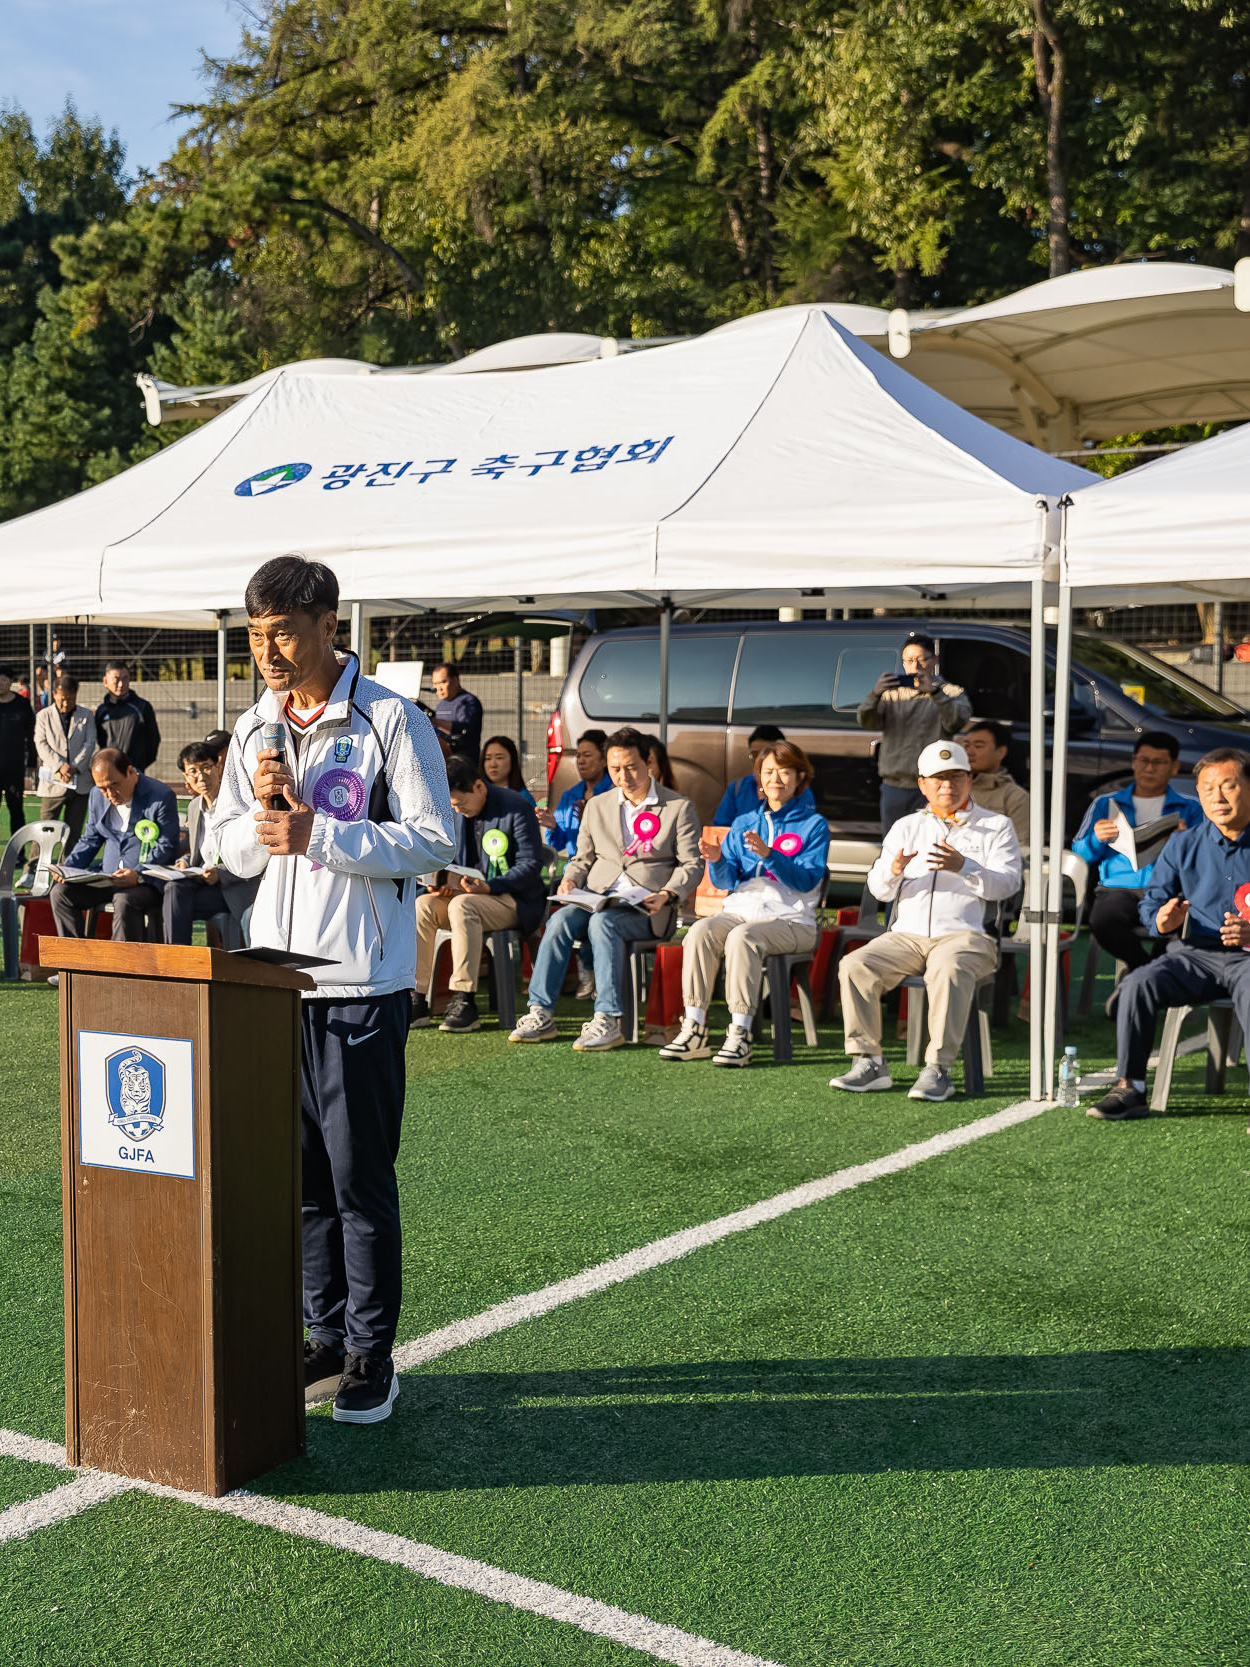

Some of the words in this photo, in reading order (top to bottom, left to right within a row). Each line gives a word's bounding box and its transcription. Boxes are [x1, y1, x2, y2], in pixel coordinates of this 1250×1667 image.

[320, 459, 457, 490] 광진구
[470, 435, 676, 480] 축구협회
[118, 1145, 155, 1163] GJFA
